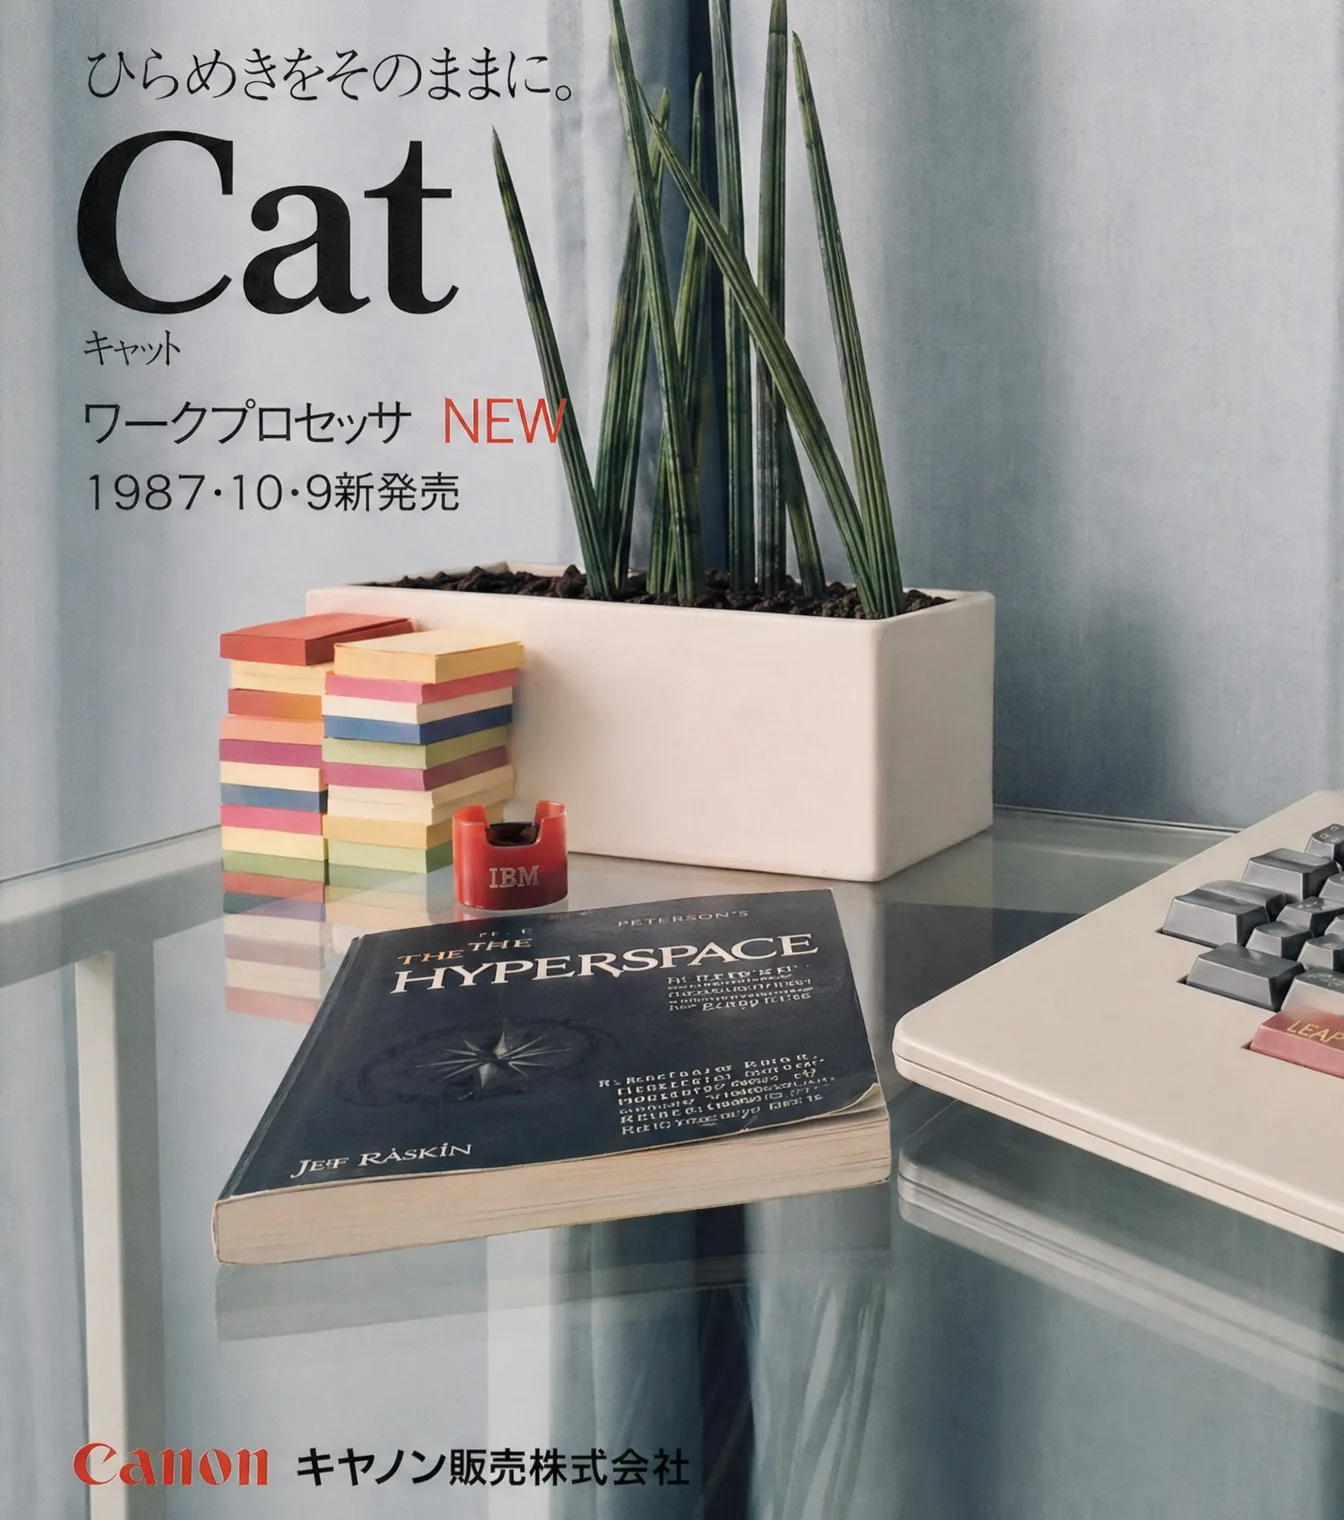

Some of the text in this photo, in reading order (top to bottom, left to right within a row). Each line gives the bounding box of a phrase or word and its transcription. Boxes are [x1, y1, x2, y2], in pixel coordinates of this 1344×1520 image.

[489, 864, 540, 889] IBM
[390, 932, 819, 994] HYPERSPACE
[398, 938, 532, 965] THE THE
